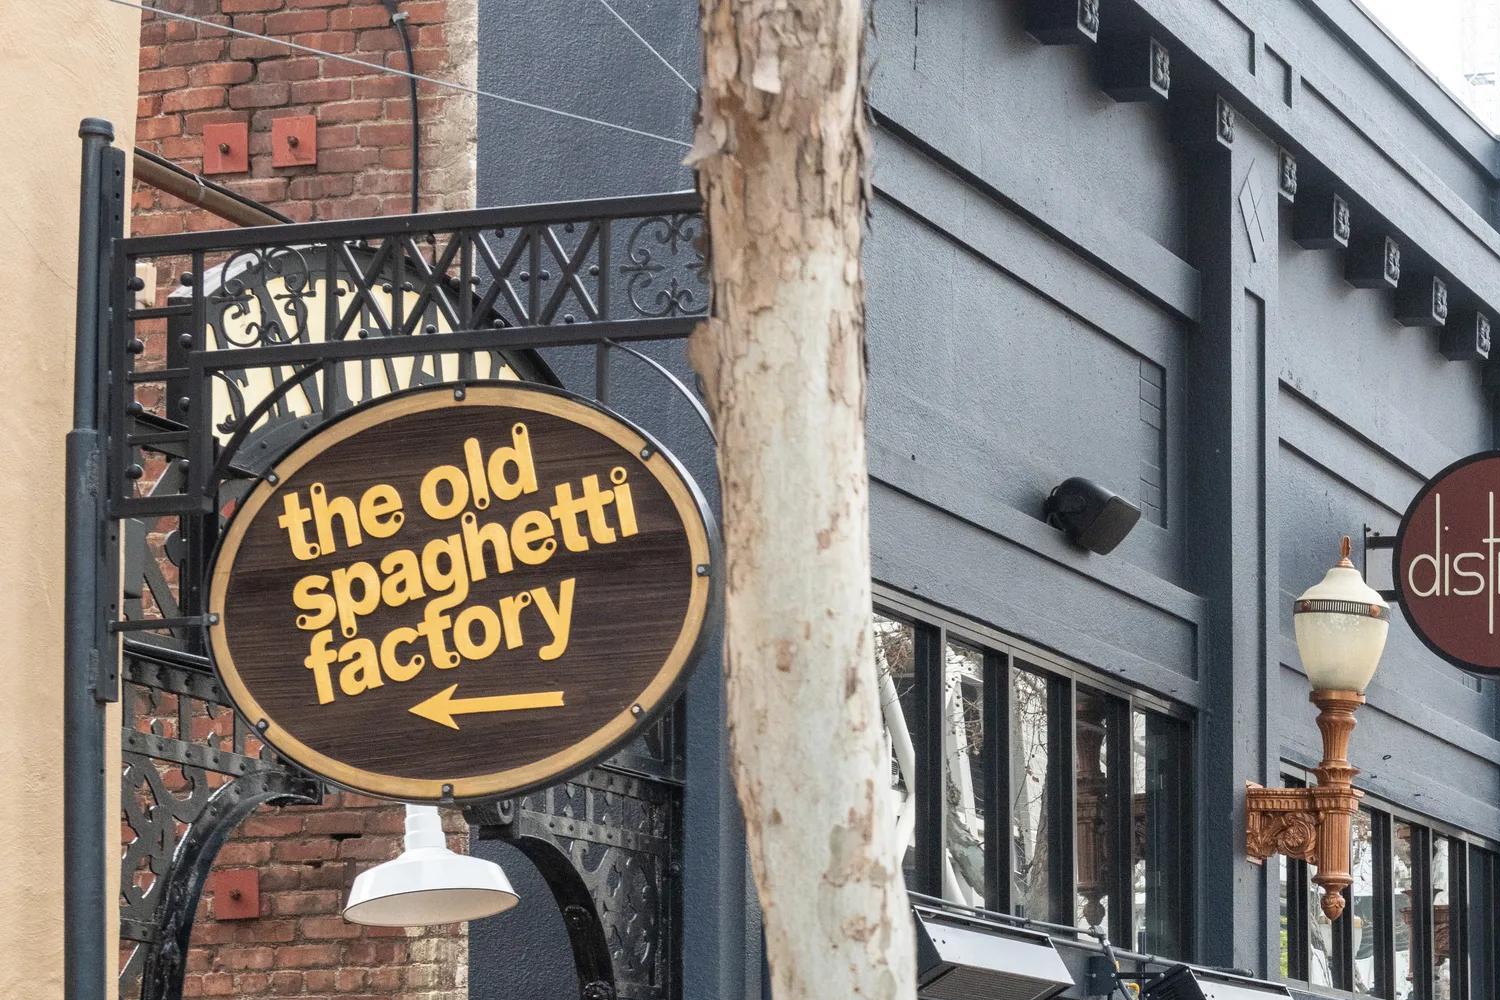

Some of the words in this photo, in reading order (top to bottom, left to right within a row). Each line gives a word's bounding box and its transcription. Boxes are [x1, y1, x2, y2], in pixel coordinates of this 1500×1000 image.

[278, 482, 405, 561] the
[419, 421, 538, 521] old
[292, 466, 639, 639] spaghetti
[304, 577, 577, 705] factory
